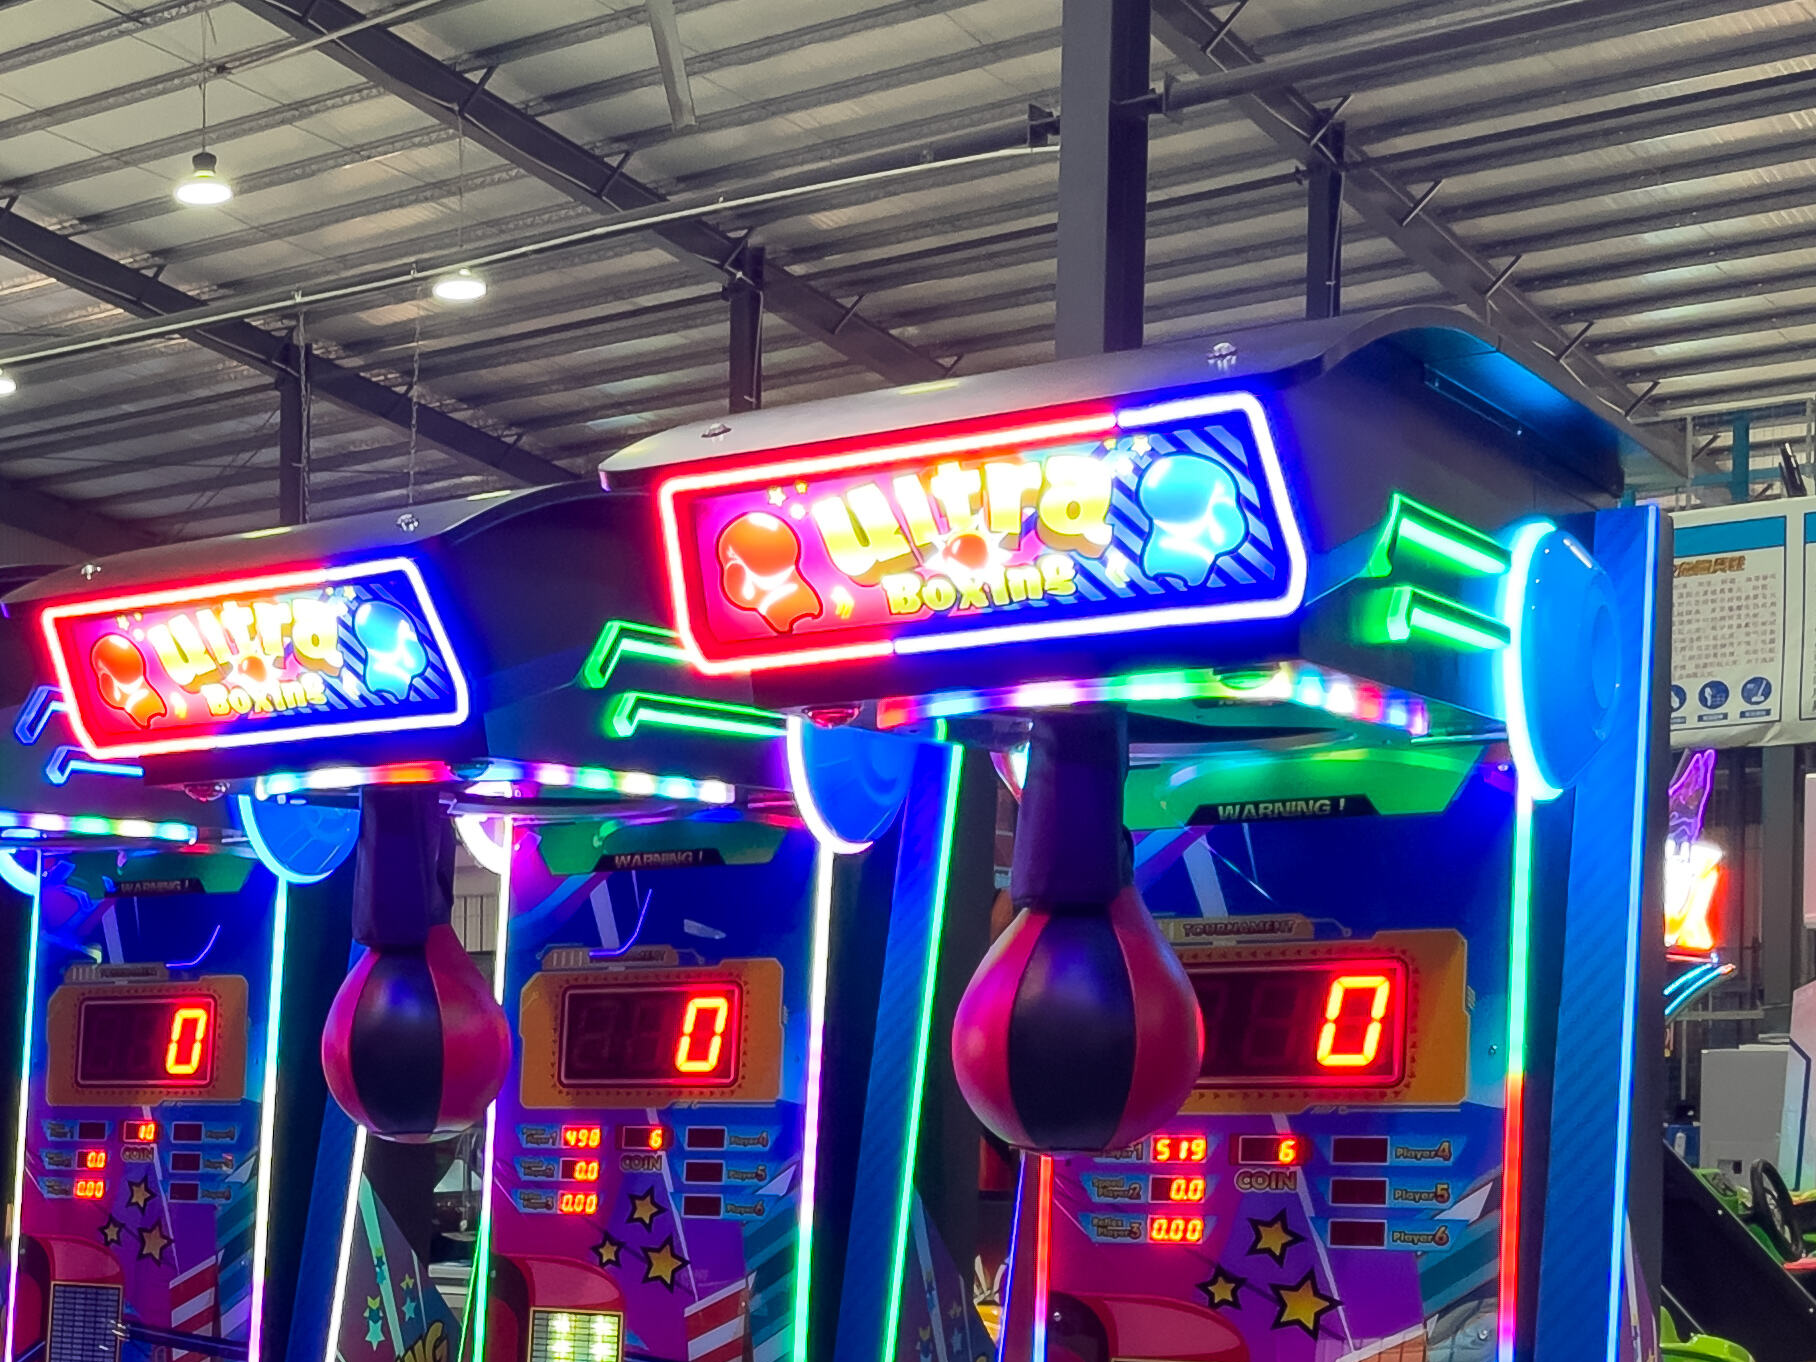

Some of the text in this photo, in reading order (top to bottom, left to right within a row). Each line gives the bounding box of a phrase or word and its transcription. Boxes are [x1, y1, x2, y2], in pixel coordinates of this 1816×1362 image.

[882, 554, 1077, 617] Boxing
[1218, 799, 1331, 821] WARNING
[1315, 975, 1390, 1067] 0
[165, 1008, 208, 1075] 0
[674, 997, 729, 1073] 0
[1156, 1138, 1207, 1162] 519
[1279, 1139, 1296, 1163] 6
[620, 1154, 663, 1172] COIN
[1169, 1178, 1206, 1200] 0.0
[1235, 1169, 1298, 1191] COIN
[1151, 1218, 1204, 1241] 0.00
